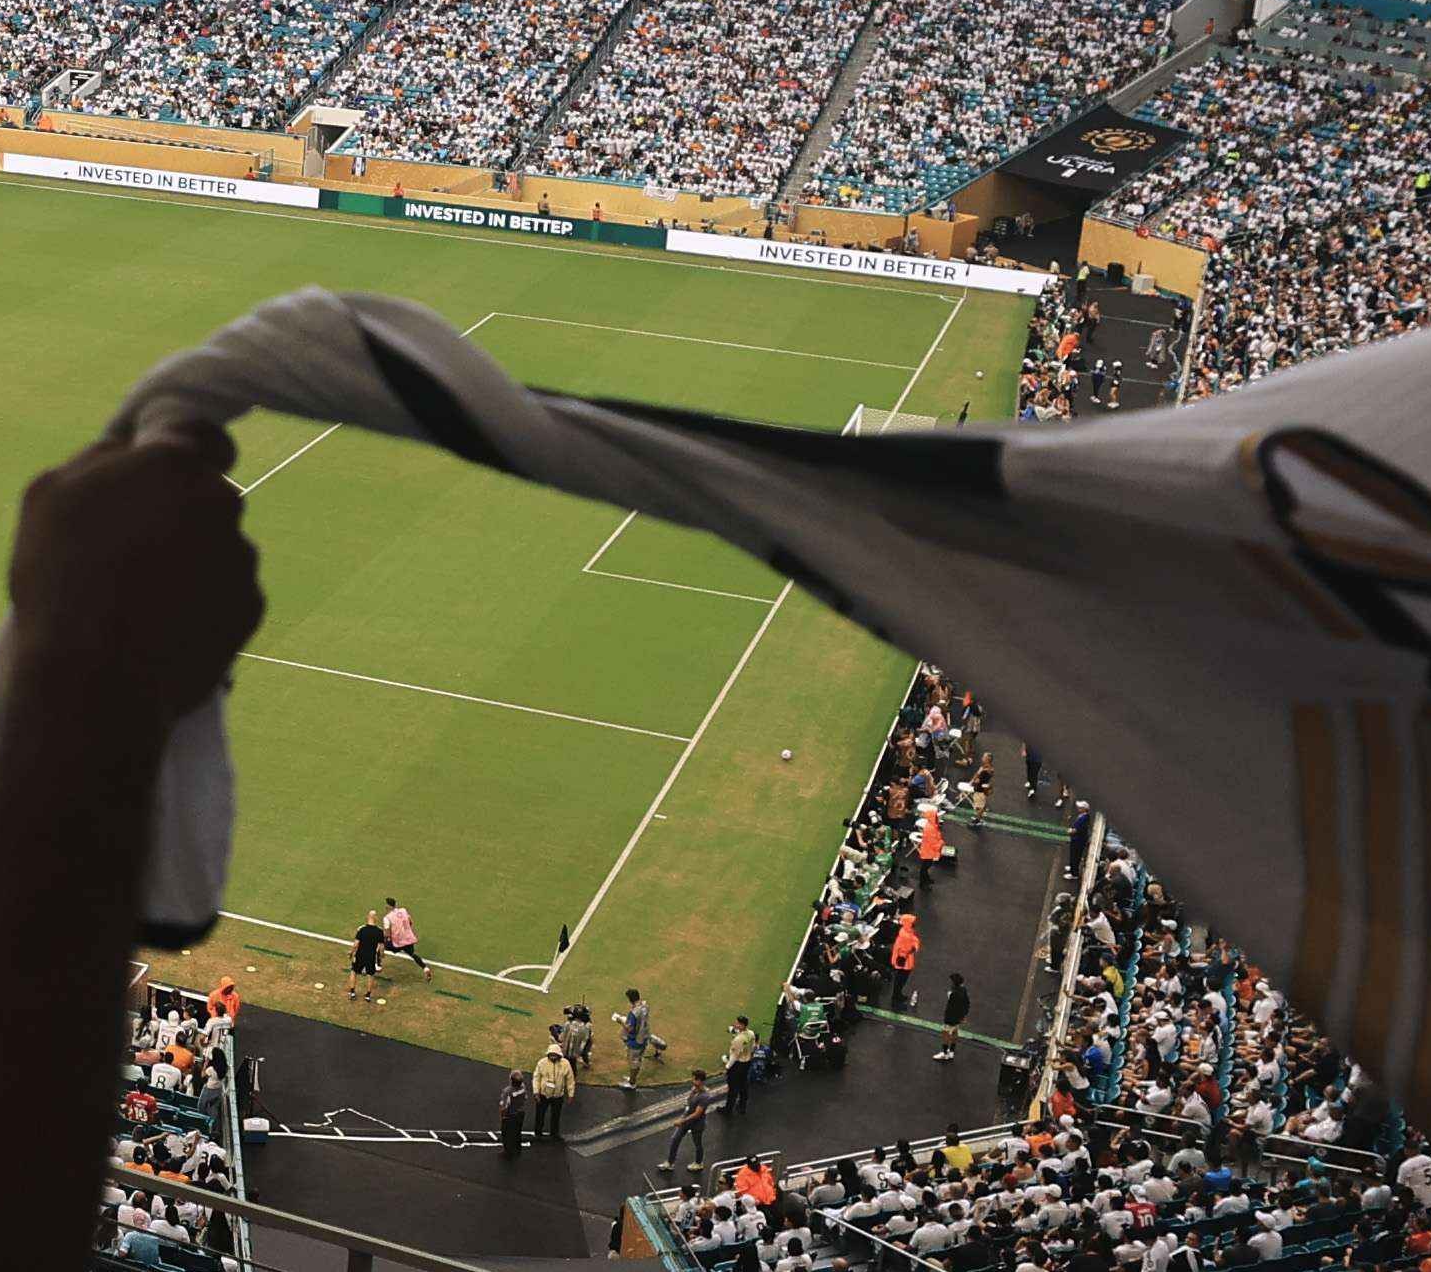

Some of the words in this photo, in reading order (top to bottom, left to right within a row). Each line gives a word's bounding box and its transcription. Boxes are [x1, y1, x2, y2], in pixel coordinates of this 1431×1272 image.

[78, 165, 153, 185] INVESTED
[157, 173, 173, 187] IN
[178, 177, 236, 194] BETTER
[405, 203, 484, 225] INVESTED
[488, 213, 505, 228] IN
[759, 244, 852, 267] INVESTED
[859, 255, 877, 270] IN
[883, 258, 956, 280] BETTER
